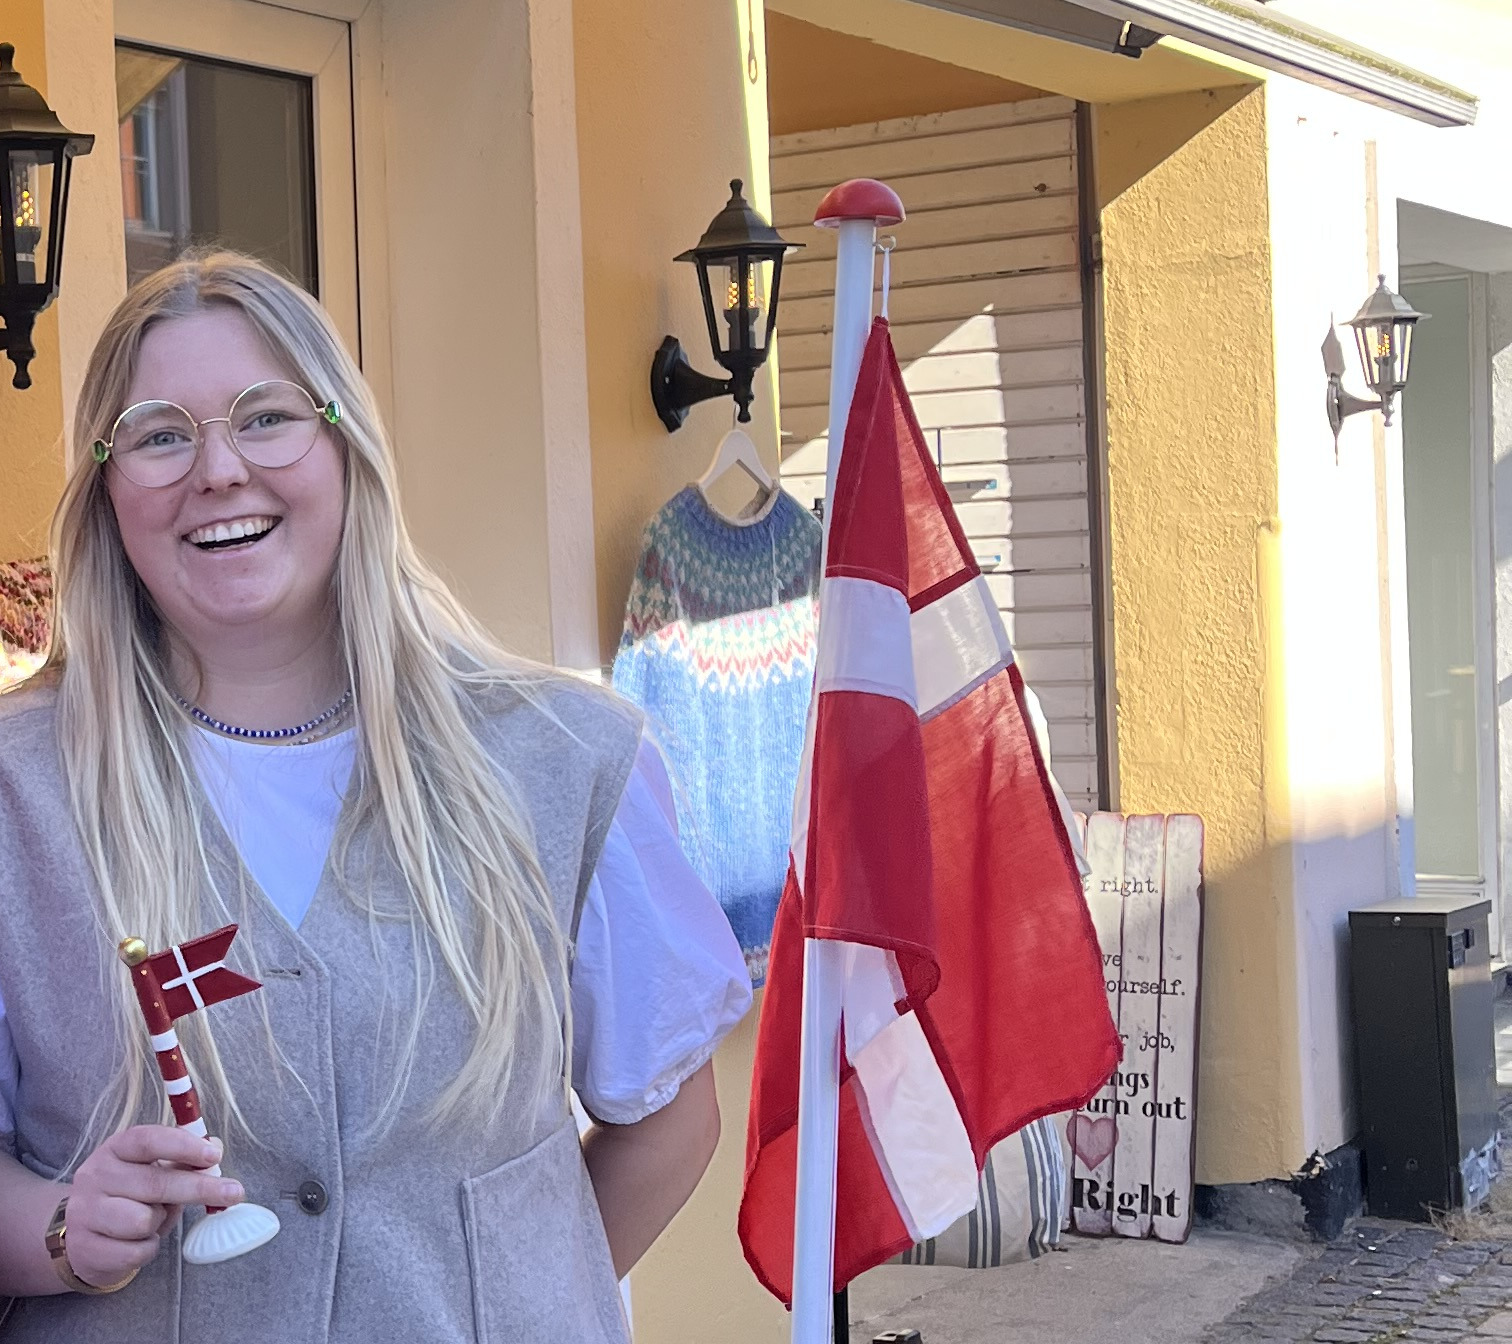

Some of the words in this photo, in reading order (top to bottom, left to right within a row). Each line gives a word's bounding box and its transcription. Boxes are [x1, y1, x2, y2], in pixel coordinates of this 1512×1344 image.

[1099, 876, 1159, 897] right.
[1101, 953, 1122, 967] ve
[1104, 978, 1186, 996] ourself.
[1139, 1031, 1175, 1052] job,
[1105, 1070, 1150, 1097] ngs
[1077, 1097, 1129, 1115] urn
[1141, 1096, 1187, 1121] out
[1072, 1177, 1182, 1223] Right
